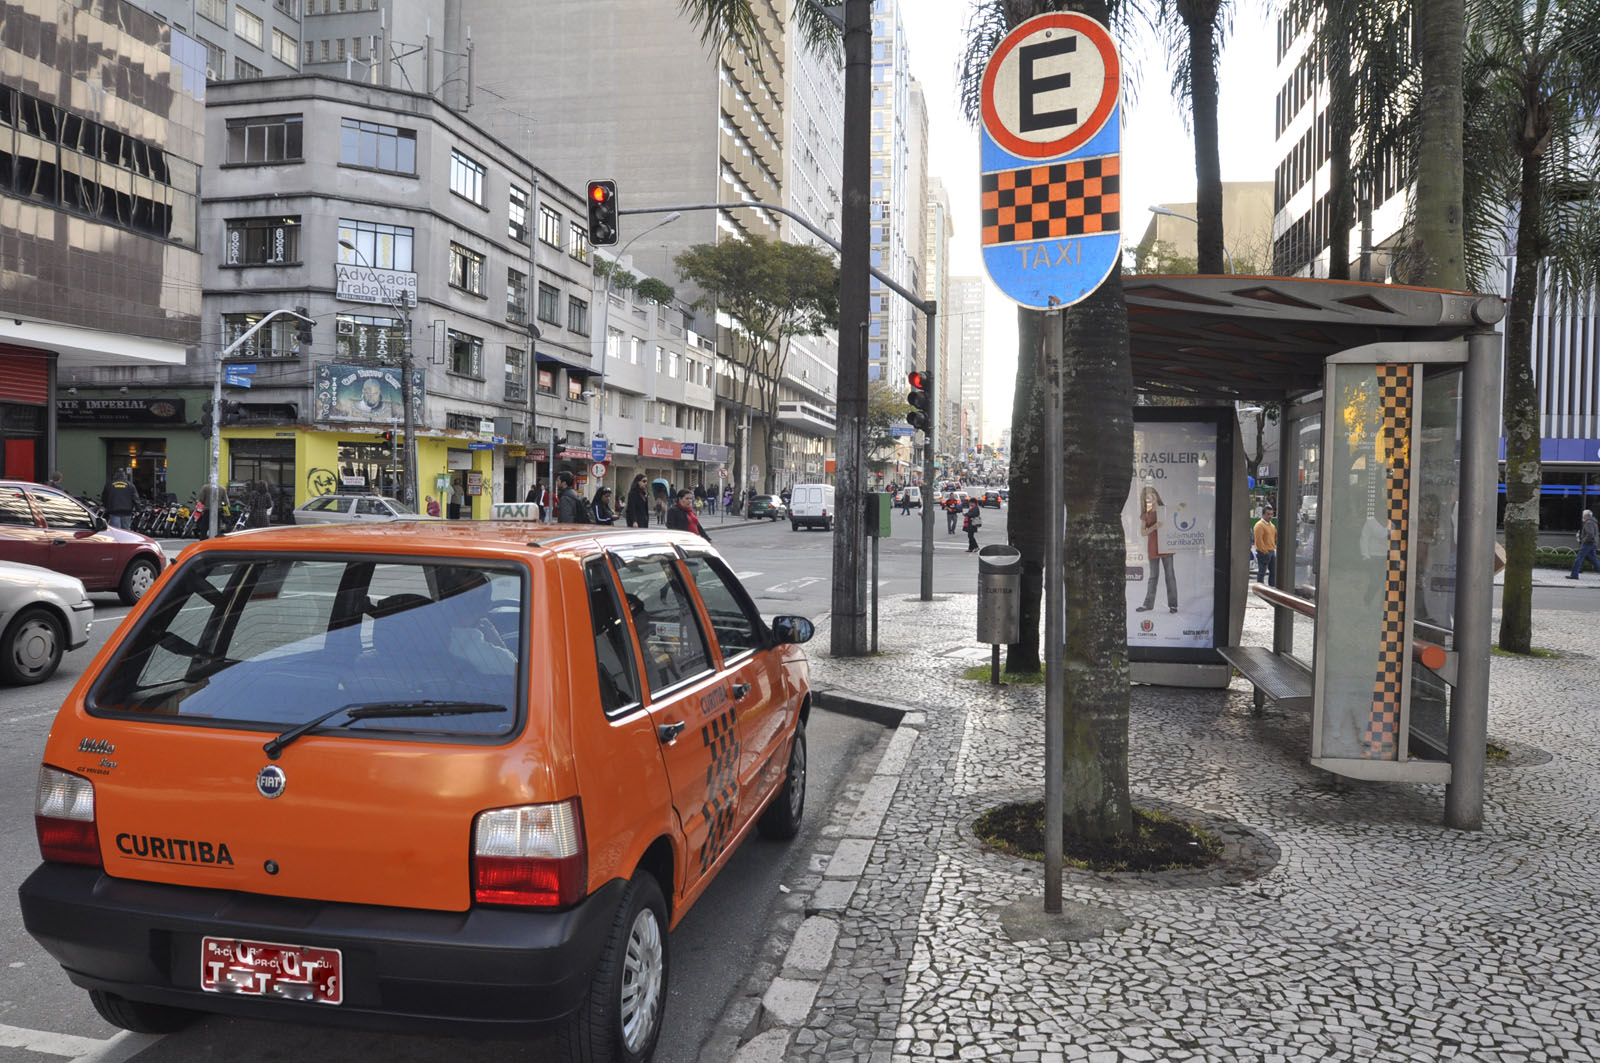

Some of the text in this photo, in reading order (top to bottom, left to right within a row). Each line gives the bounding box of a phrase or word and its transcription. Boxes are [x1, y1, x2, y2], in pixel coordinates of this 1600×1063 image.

[1020, 36, 1077, 133] E
[1016, 241, 1081, 270] TAXI
[338, 266, 416, 287] Advocacia
[338, 280, 416, 300] Trabalhisa
[86, 400, 147, 409] IMPERIAL
[494, 504, 529, 518] TAXI
[260, 775, 281, 788] FIAT
[115, 832, 234, 865] CURITIBA
